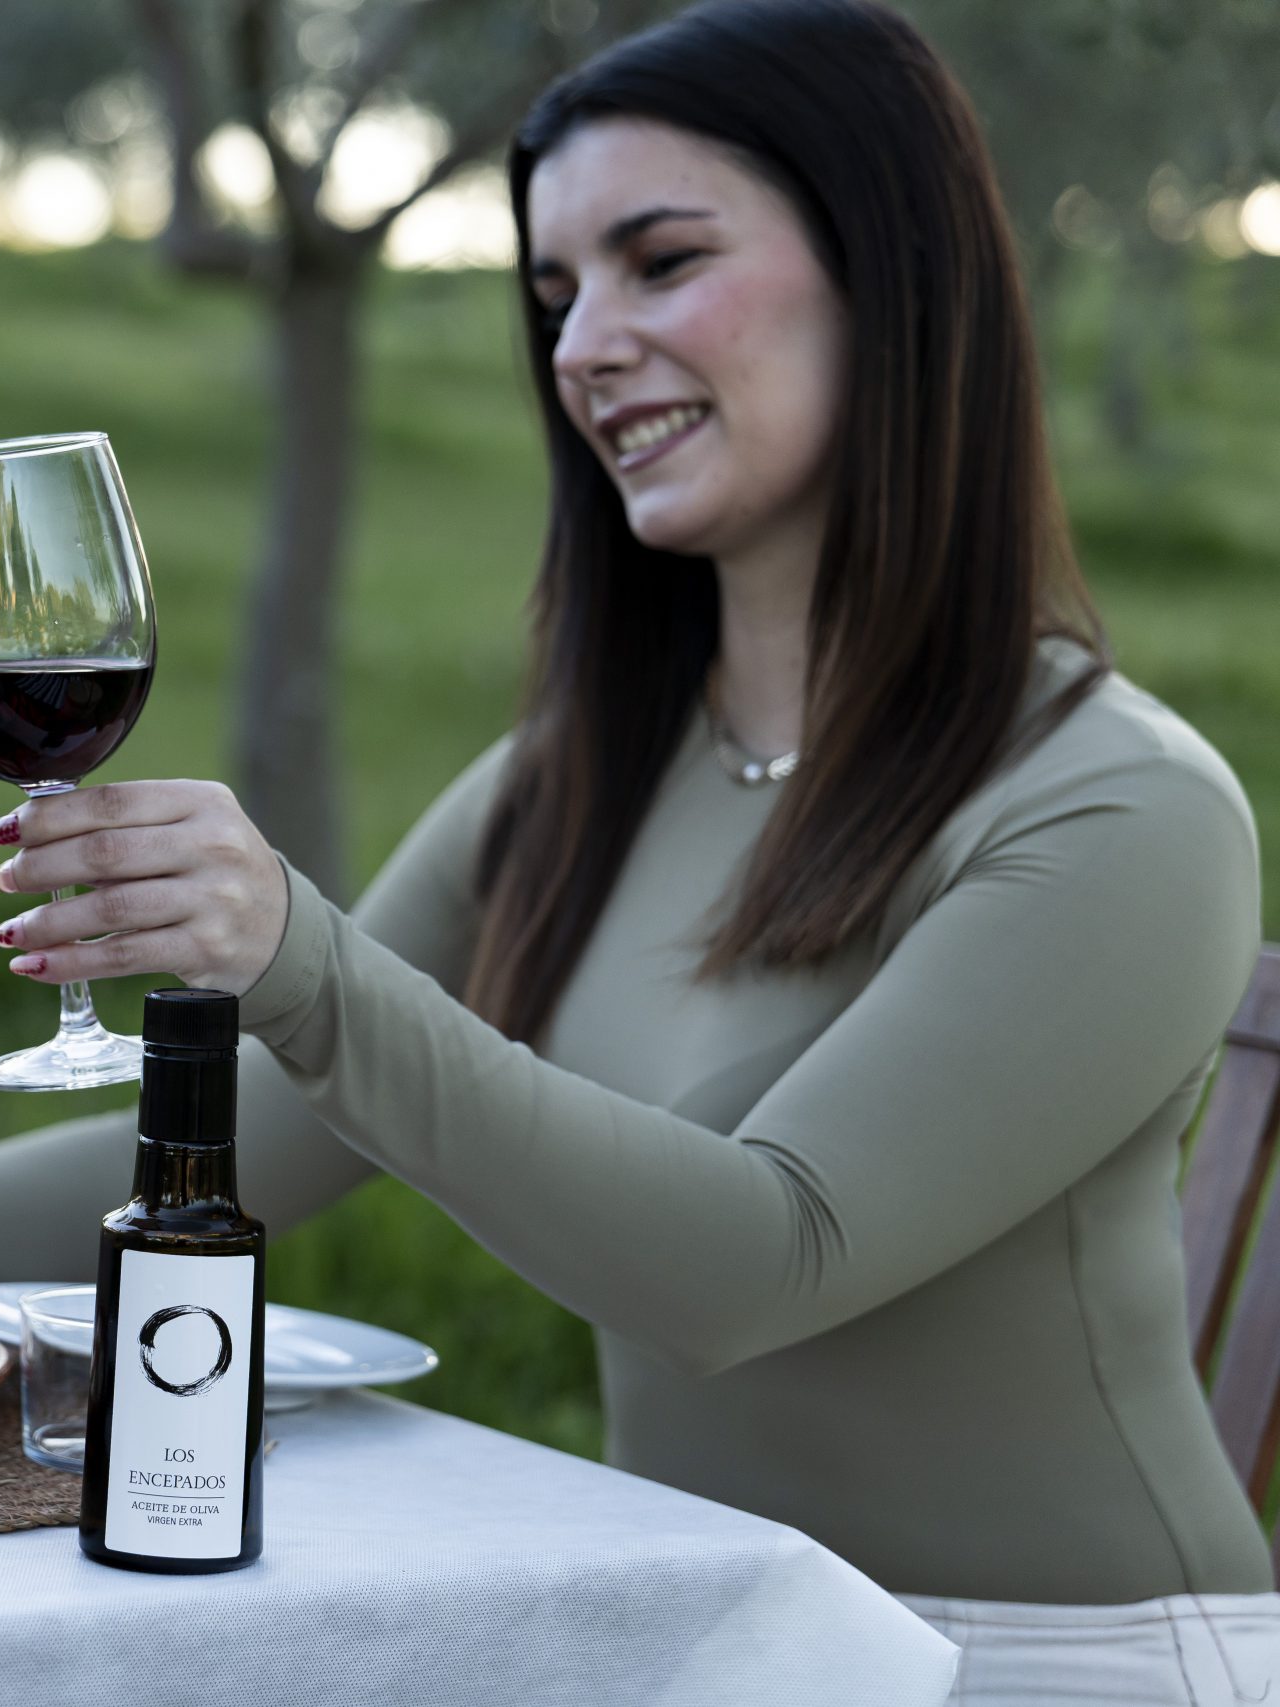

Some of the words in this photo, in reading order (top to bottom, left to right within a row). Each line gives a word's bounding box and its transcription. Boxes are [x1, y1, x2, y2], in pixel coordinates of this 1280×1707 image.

[164, 1448, 195, 1463] LOS
[129, 1469, 226, 1490] ENCEPADOS
[131, 1501, 169, 1513] ACEITE
[172, 1504, 187, 1514] DE
[190, 1505, 220, 1514] OLIVA
[147, 1515, 176, 1526] VIRGEN
[178, 1517, 203, 1527] EXTRA
